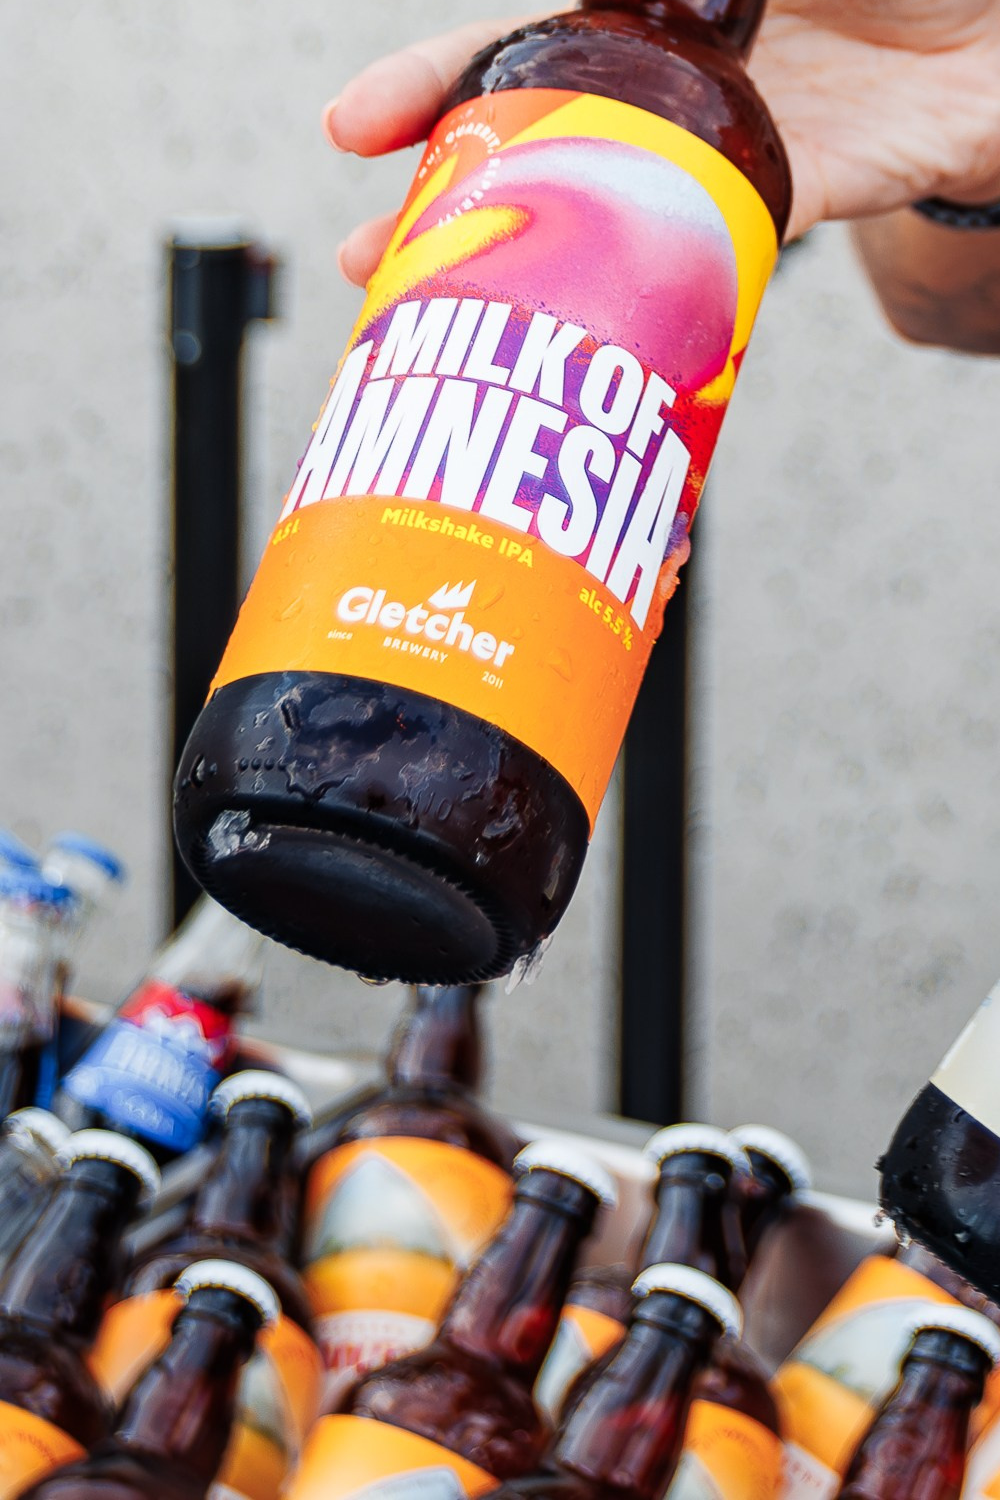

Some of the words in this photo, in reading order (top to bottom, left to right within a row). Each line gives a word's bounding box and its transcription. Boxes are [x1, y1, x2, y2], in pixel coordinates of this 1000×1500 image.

[369, 297, 587, 407] MILK
[578, 343, 679, 454] OF
[276, 338, 692, 632] AMNESIA
[380, 506, 495, 550] Milkshake
[498, 537, 534, 569] IPA
[335, 585, 516, 669] Gletcher
[578, 585, 604, 614] alc
[327, 628, 354, 642] since
[382, 635, 449, 665] BREWERY
[480, 670, 504, 690] 2011
